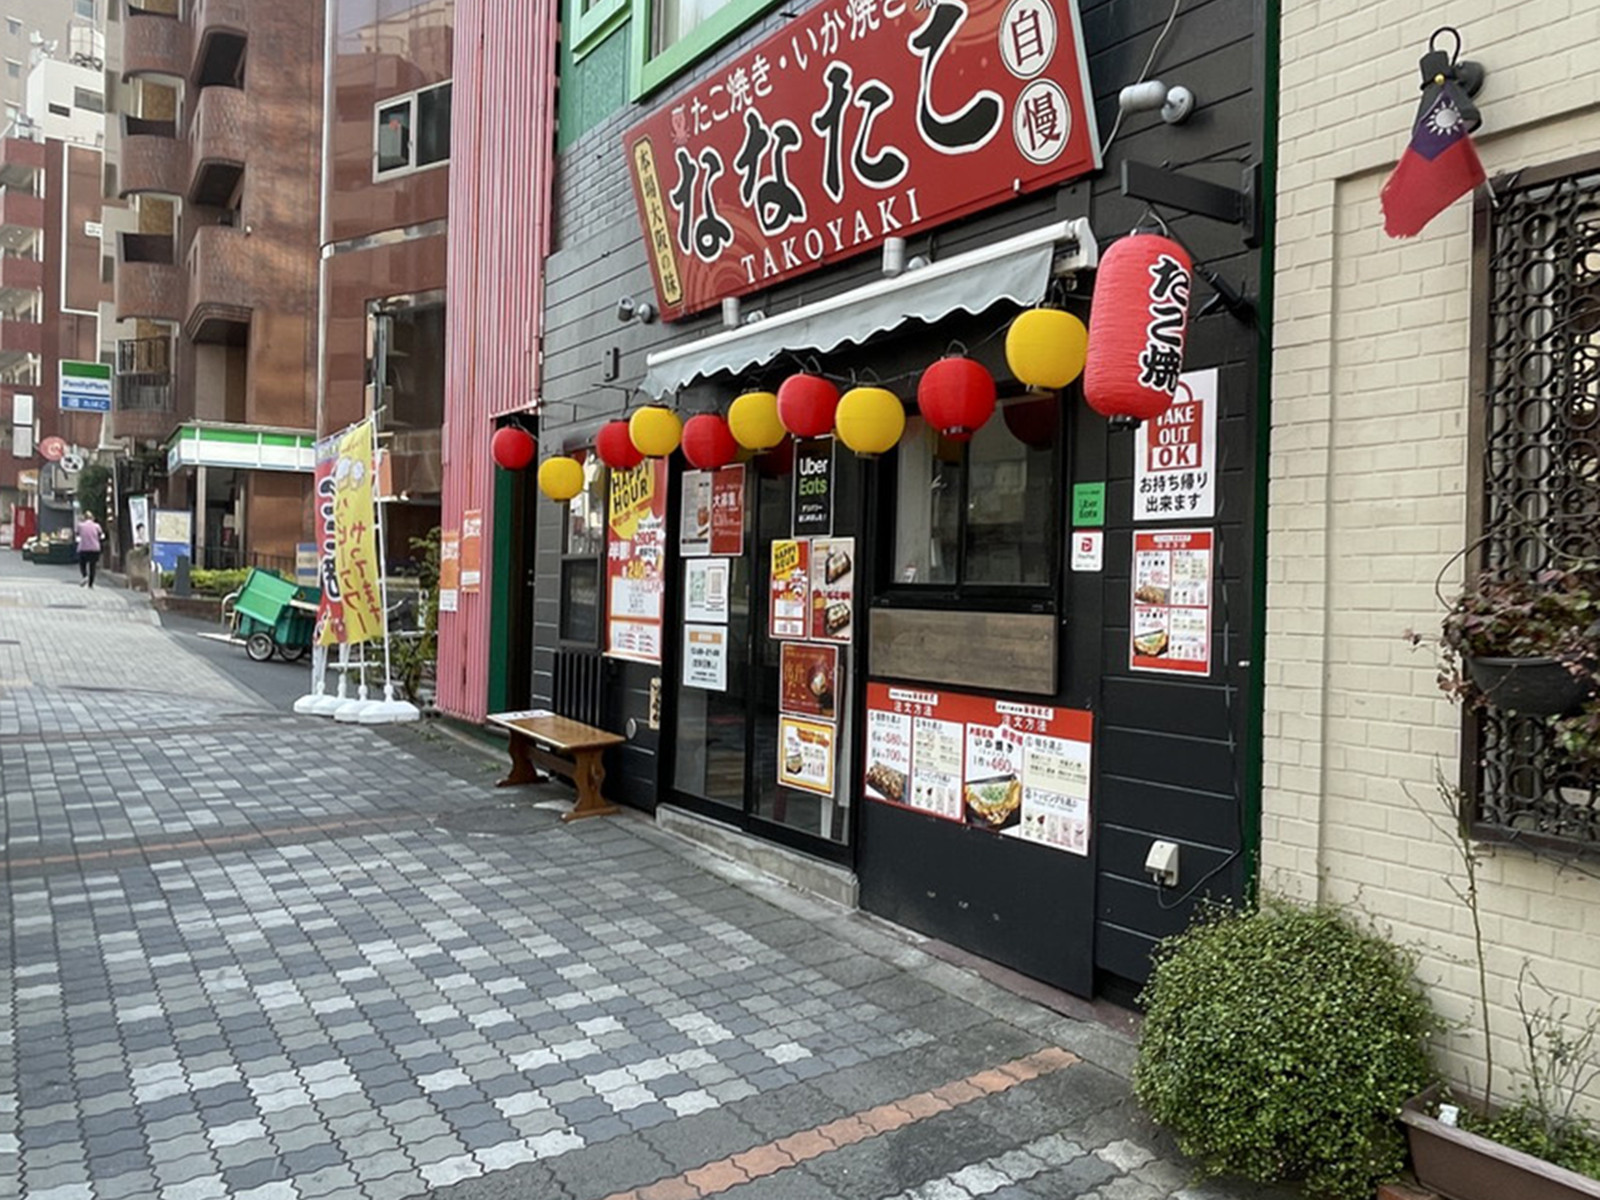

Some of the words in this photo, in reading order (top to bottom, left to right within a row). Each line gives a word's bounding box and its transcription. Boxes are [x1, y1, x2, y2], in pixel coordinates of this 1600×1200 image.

[741, 187, 922, 286] TAKOYAKI
[1158, 426, 1191, 446] OUT
[799, 456, 828, 476] Uber
[1158, 445, 1191, 467] OK
[798, 477, 828, 496] Eats
[1139, 472, 1208, 493] お持ち帰り
[613, 478, 648, 515] HOUR
[1145, 493, 1202, 513] 出来ます
